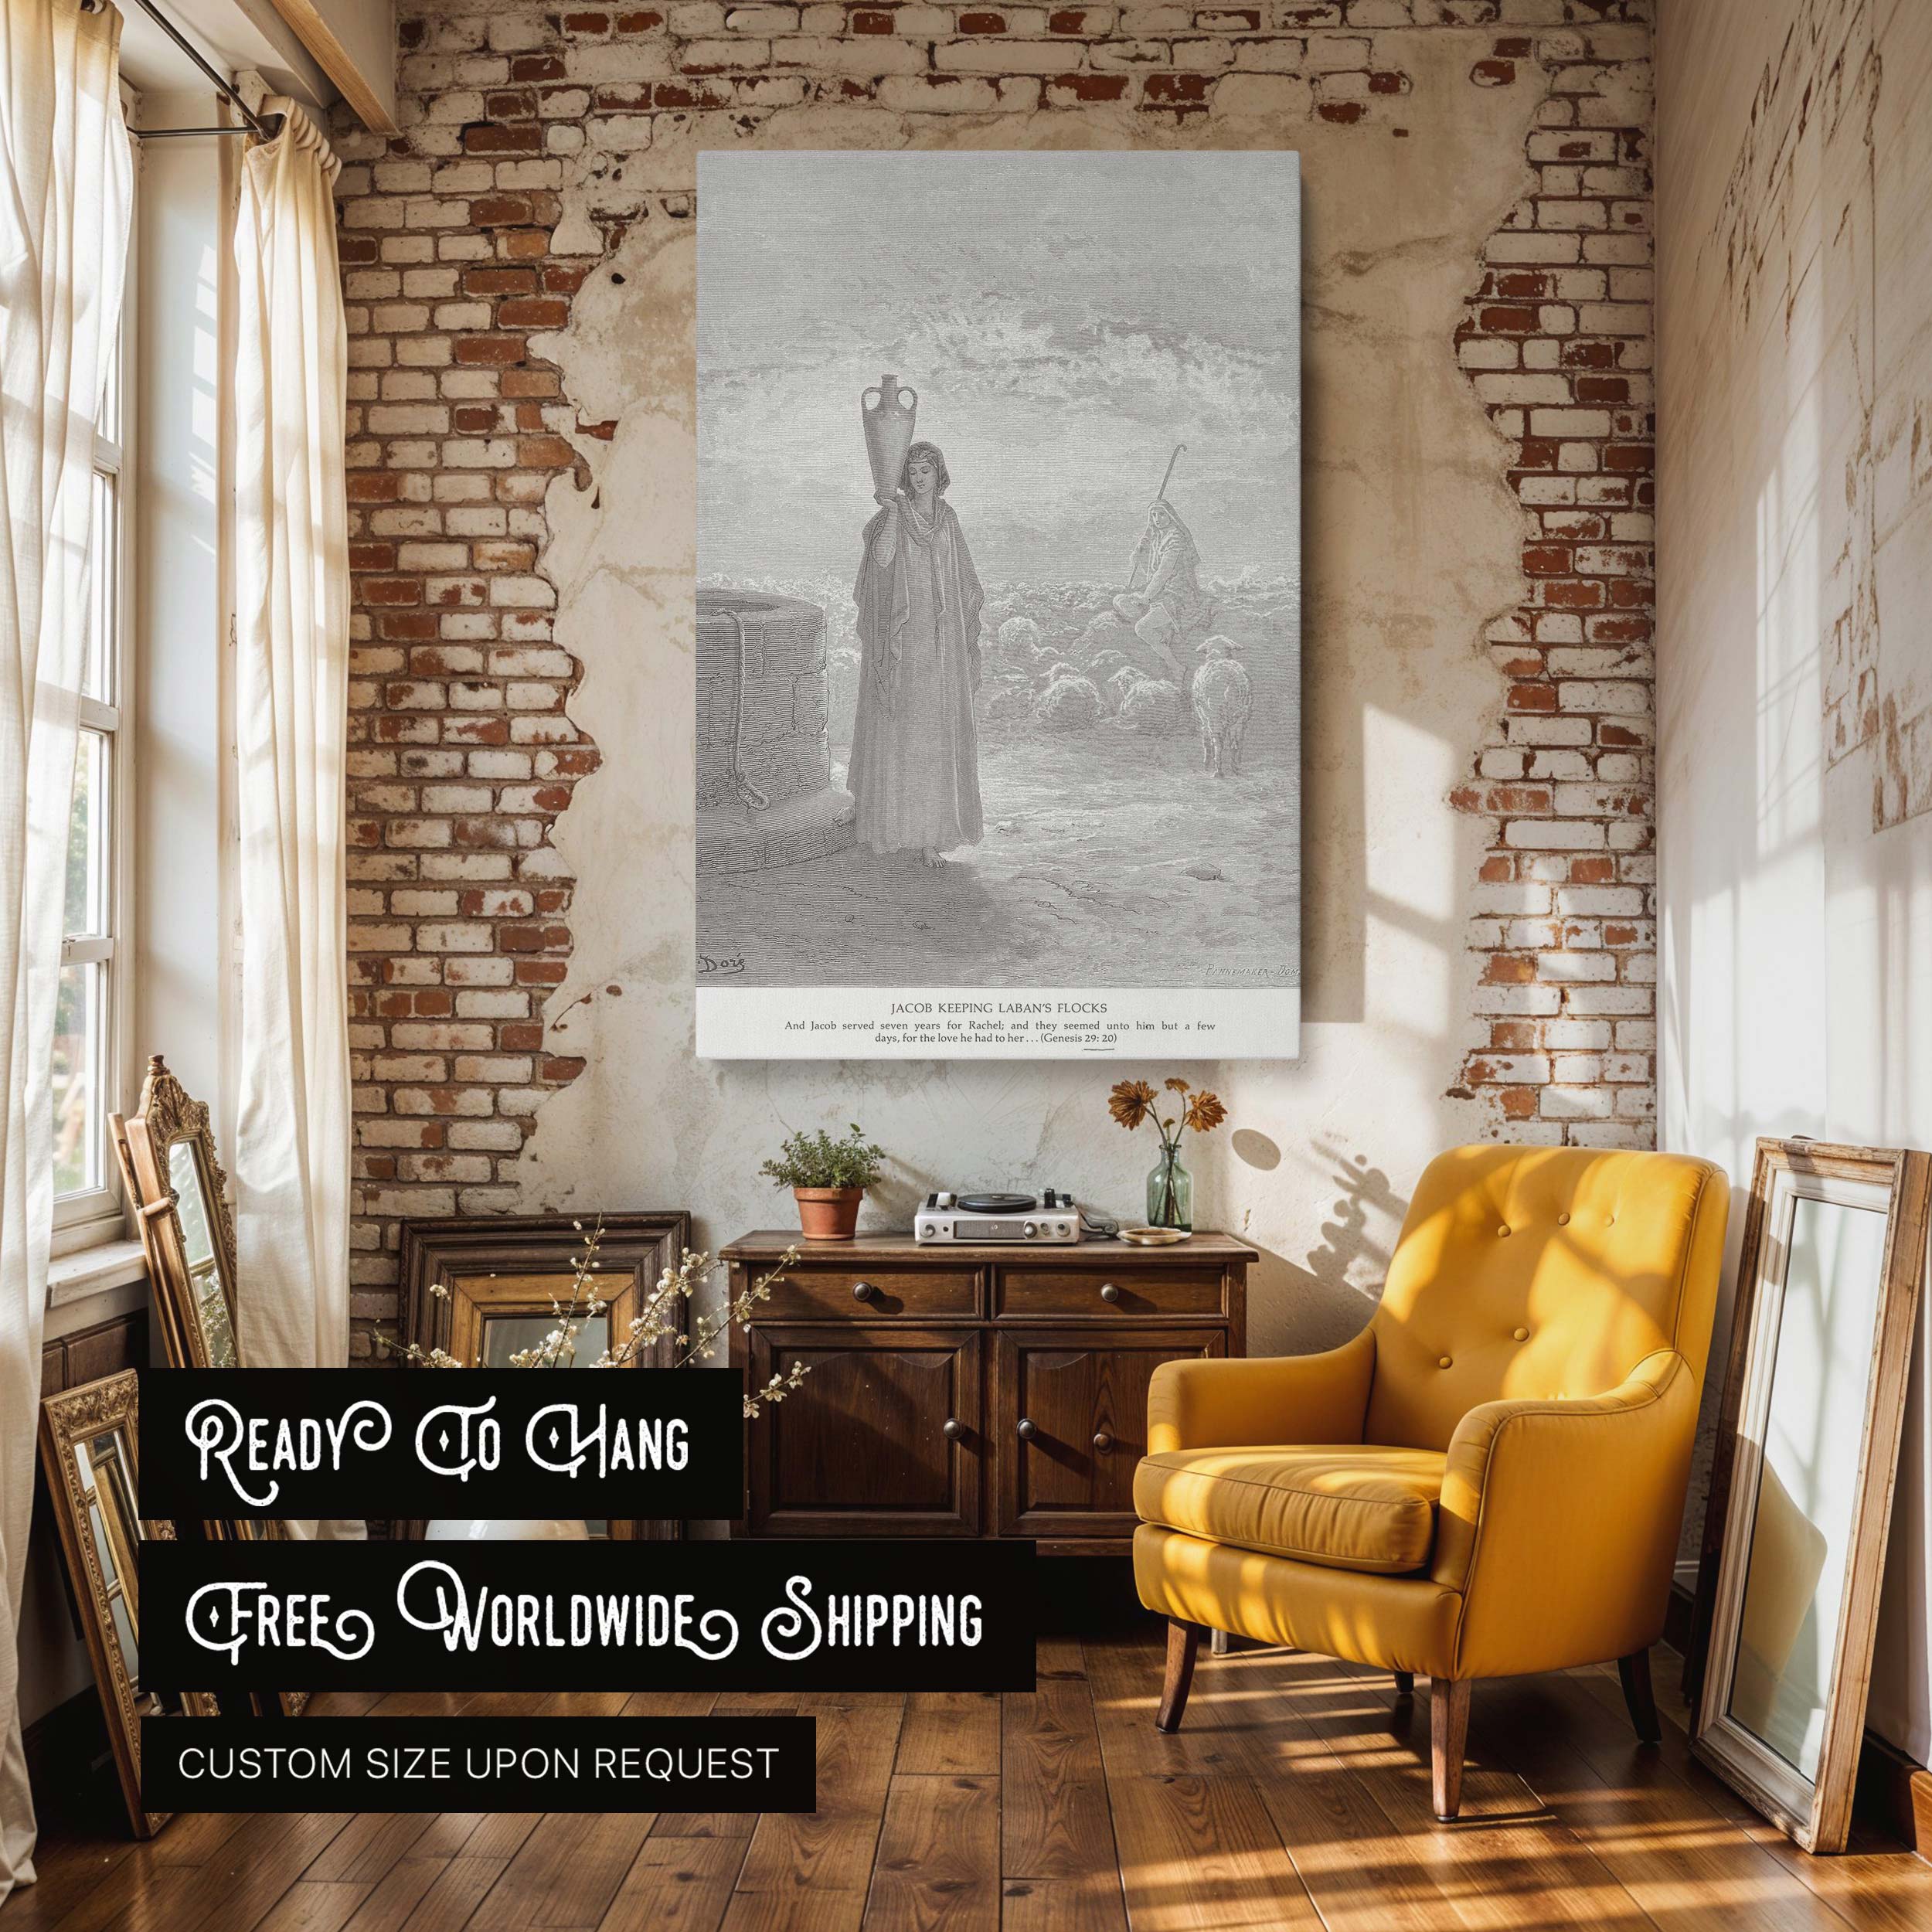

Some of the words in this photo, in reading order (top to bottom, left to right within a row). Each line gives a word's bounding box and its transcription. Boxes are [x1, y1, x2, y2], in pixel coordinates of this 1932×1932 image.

[891, 1002, 933, 1015] JACOB
[938, 1002, 993, 1013] KEEPING
[998, 1002, 1052, 1013] LABAN'S
[1057, 1002, 1107, 1013] FLOCKS
[784, 1020, 805, 1030] And
[811, 1020, 837, 1031] Jacob
[842, 1020, 874, 1030] served
[914, 1022, 940, 1032] years
[947, 1020, 962, 1030] for
[968, 1020, 1005, 1031] Rachel;
[1011, 1020, 1029, 1030] and
[1036, 1020, 1057, 1032] they
[1063, 1020, 1100, 1030] seemed
[1107, 1022, 1130, 1030] unto
[1136, 1020, 1155, 1030] him
[1162, 1020, 1179, 1030] but
[1197, 1020, 1216, 1030] few
[875, 1032, 900, 1045] days,
[903, 1032, 917, 1043] for
[920, 1032, 936, 1043] the
[937, 1032, 958, 1043] love
[960, 1032, 972, 1043] he
[975, 1032, 993, 1043] had
[995, 1034, 1005, 1043] to
[1040, 1032, 1083, 1043] (Genesis
[1084, 1034, 1100, 1043] 29:
[1101, 1032, 1117, 1043] 20)
